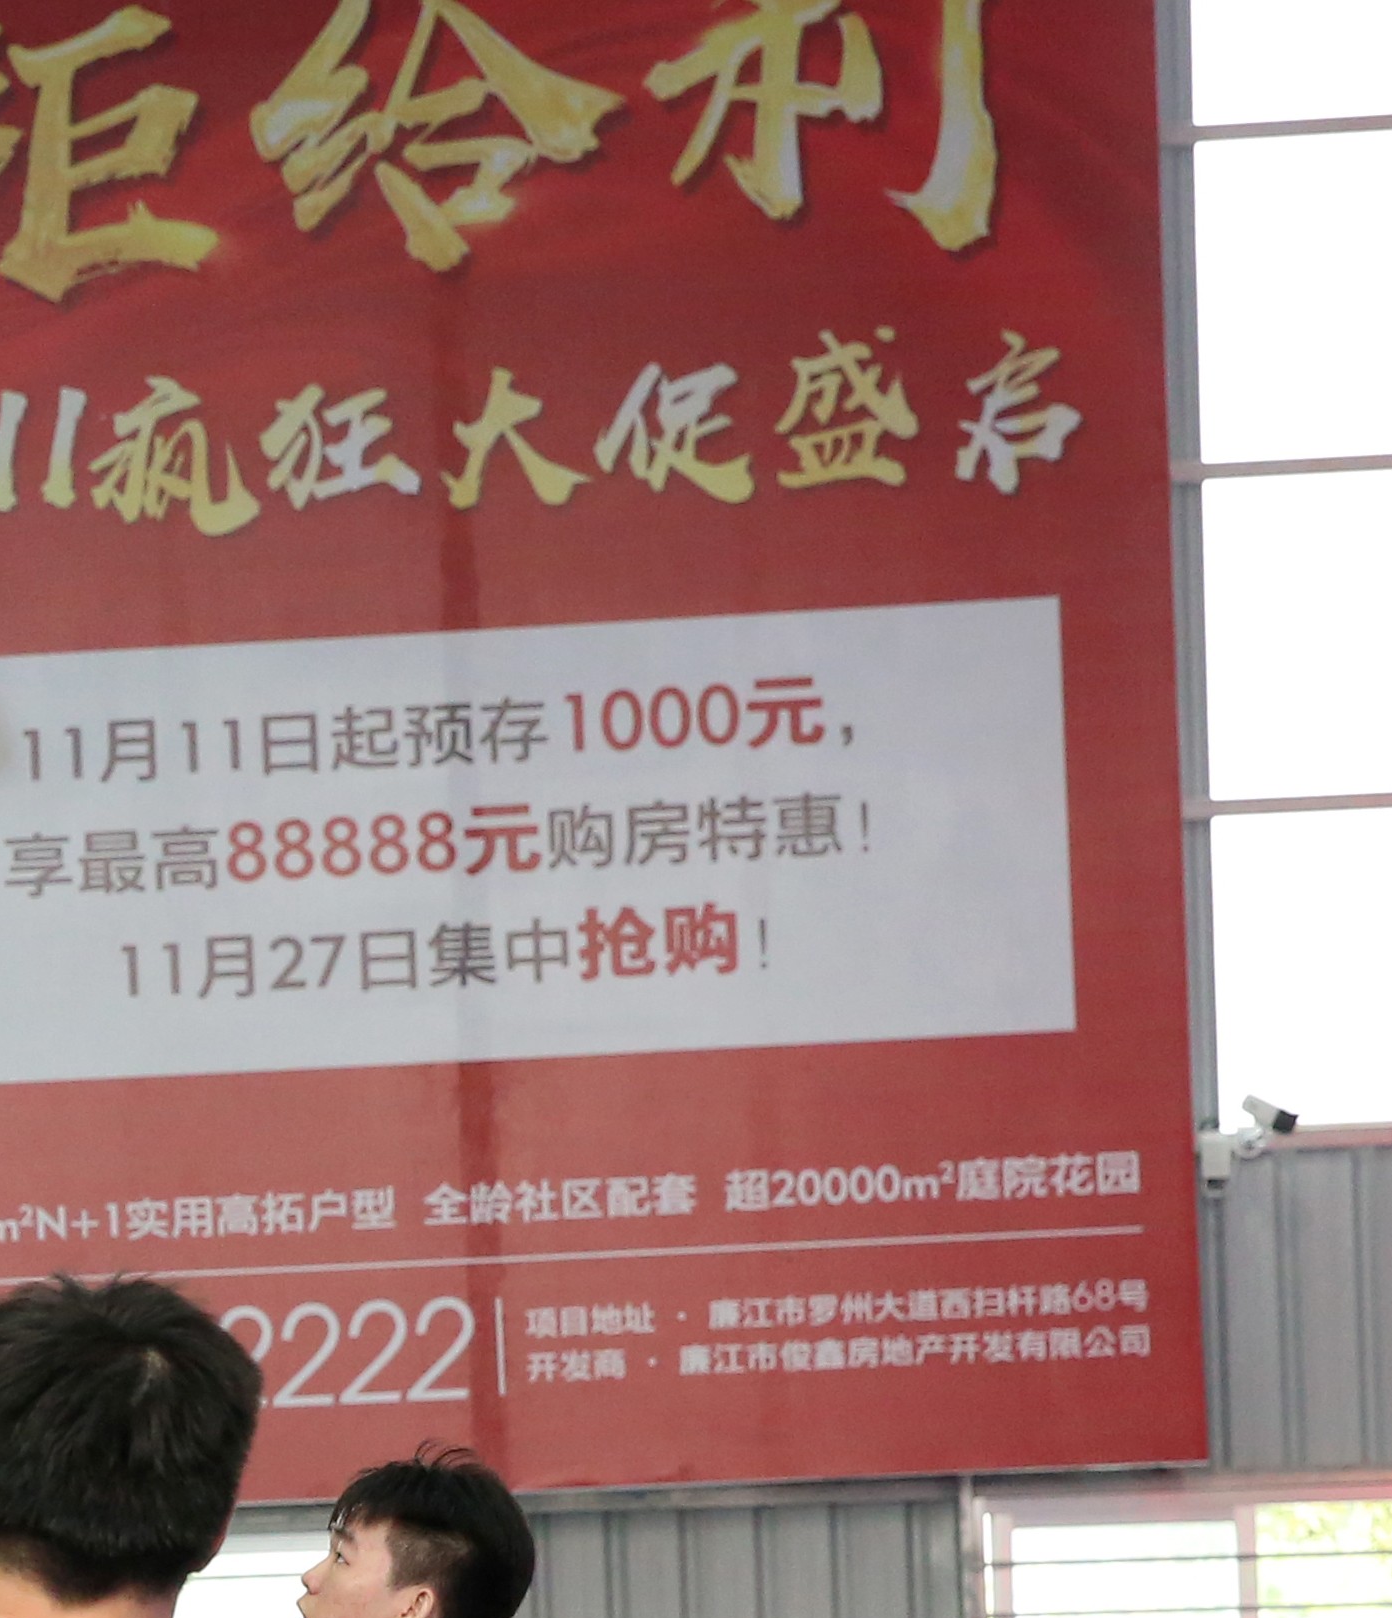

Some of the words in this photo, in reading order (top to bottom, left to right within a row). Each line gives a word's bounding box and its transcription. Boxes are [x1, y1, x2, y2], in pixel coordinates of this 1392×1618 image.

[423, 1173, 697, 1227] 全龄社区配套
[526, 1302, 655, 1340] 项目地址
[526, 1346, 628, 1382] 开发商
